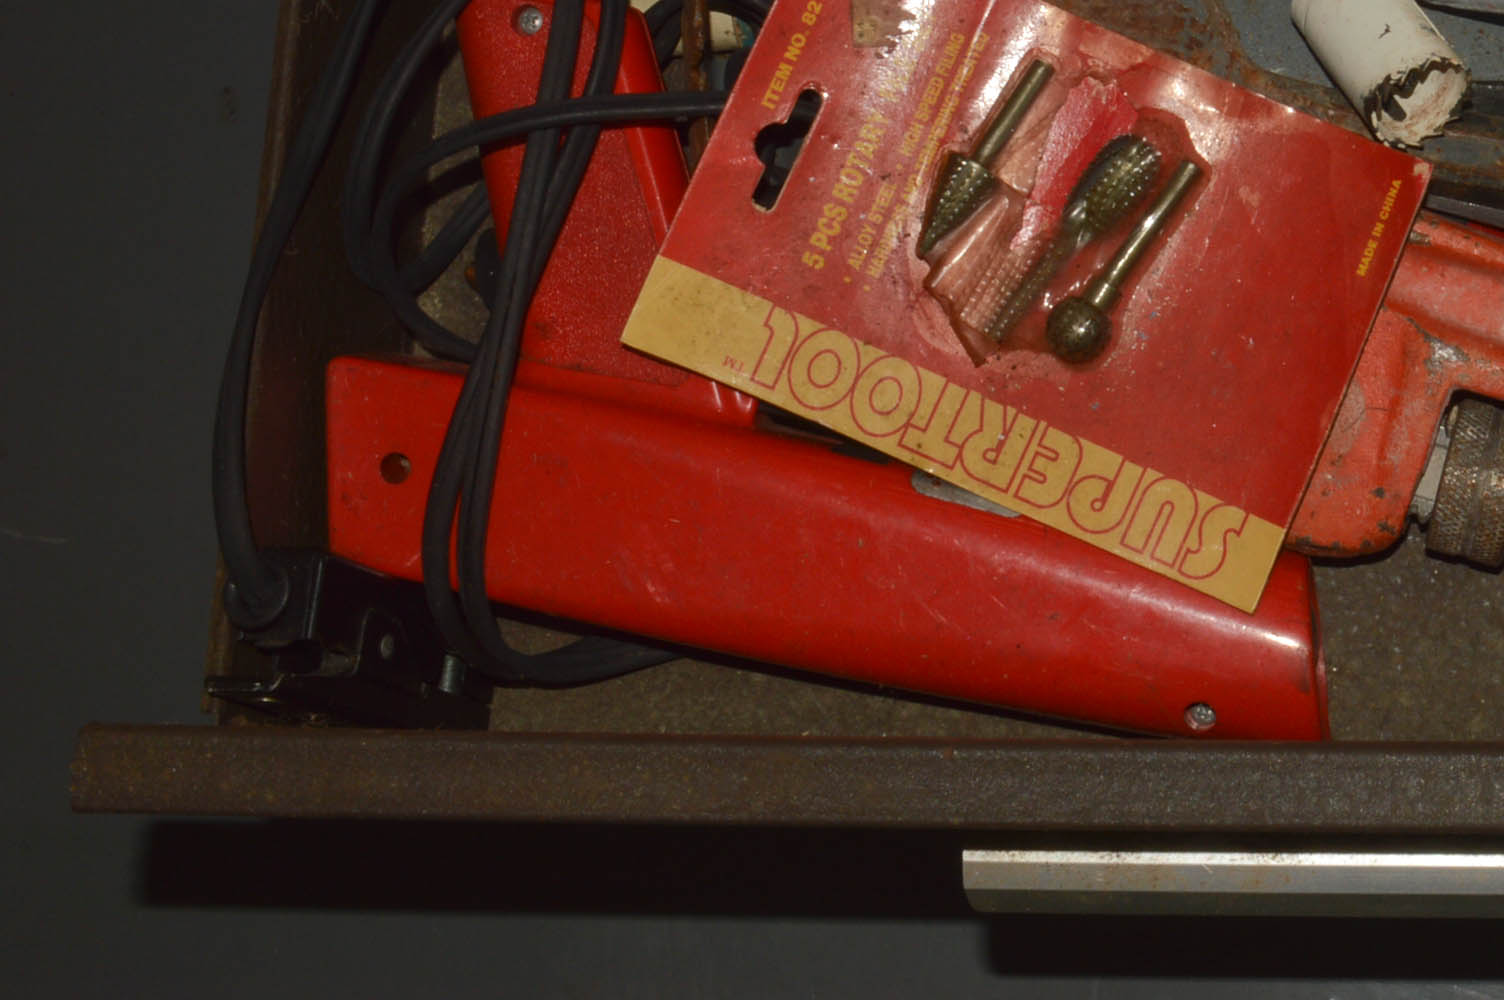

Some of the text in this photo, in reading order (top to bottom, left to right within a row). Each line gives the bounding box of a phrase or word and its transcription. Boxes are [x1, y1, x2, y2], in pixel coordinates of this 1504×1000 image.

[762, 65, 792, 109] ITEM
[784, 30, 809, 64] NO.
[833, 110, 891, 201] ROTARY
[848, 222, 875, 271] ALLOY
[867, 180, 898, 226] STEEL
[914, 71, 948, 121] SPEED
[937, 32, 966, 77] FILING
[802, 251, 825, 270] 5
[809, 203, 848, 252] PCS
[1356, 180, 1402, 276] MADE IN CHINA
[751, 306, 1246, 579] SUPERTOOL
